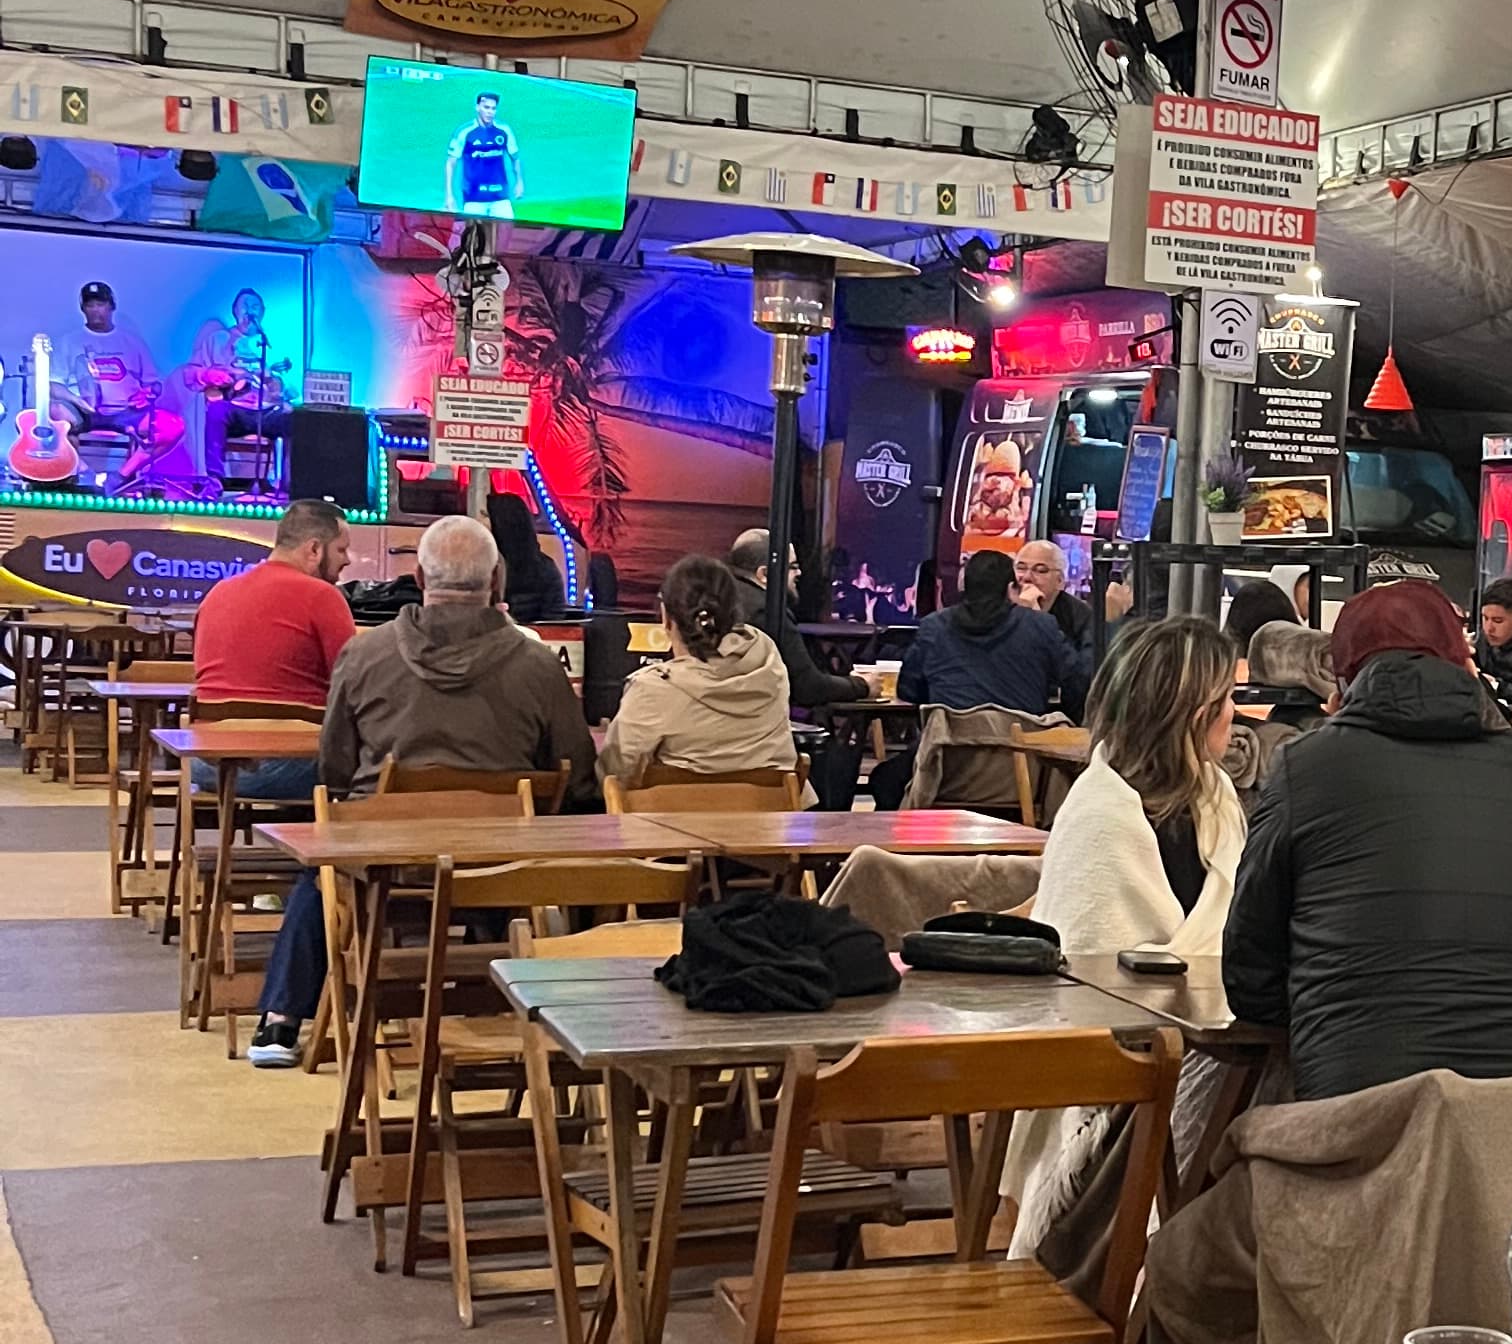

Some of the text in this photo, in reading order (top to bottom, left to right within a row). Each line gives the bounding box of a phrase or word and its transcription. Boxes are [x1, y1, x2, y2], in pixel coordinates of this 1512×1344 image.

[1220, 68, 1270, 92] FUMAR
[1158, 101, 1317, 146] SEJA EDUCADO!
[1164, 140, 1211, 157] PROIBIDO
[1213, 146, 1263, 163] CONSUMIR
[1265, 153, 1314, 170] ALIMENTOS
[1177, 158, 1217, 174] BEBIDAS
[1220, 163, 1277, 182] COMPRADOS
[1179, 175, 1191, 187] DA
[1194, 176, 1215, 190] VILA
[1163, 200, 1304, 240] ¡SER CORTÉS!
[1303, 332, 1335, 355] GRILL
[44, 544, 83, 573] Eu
